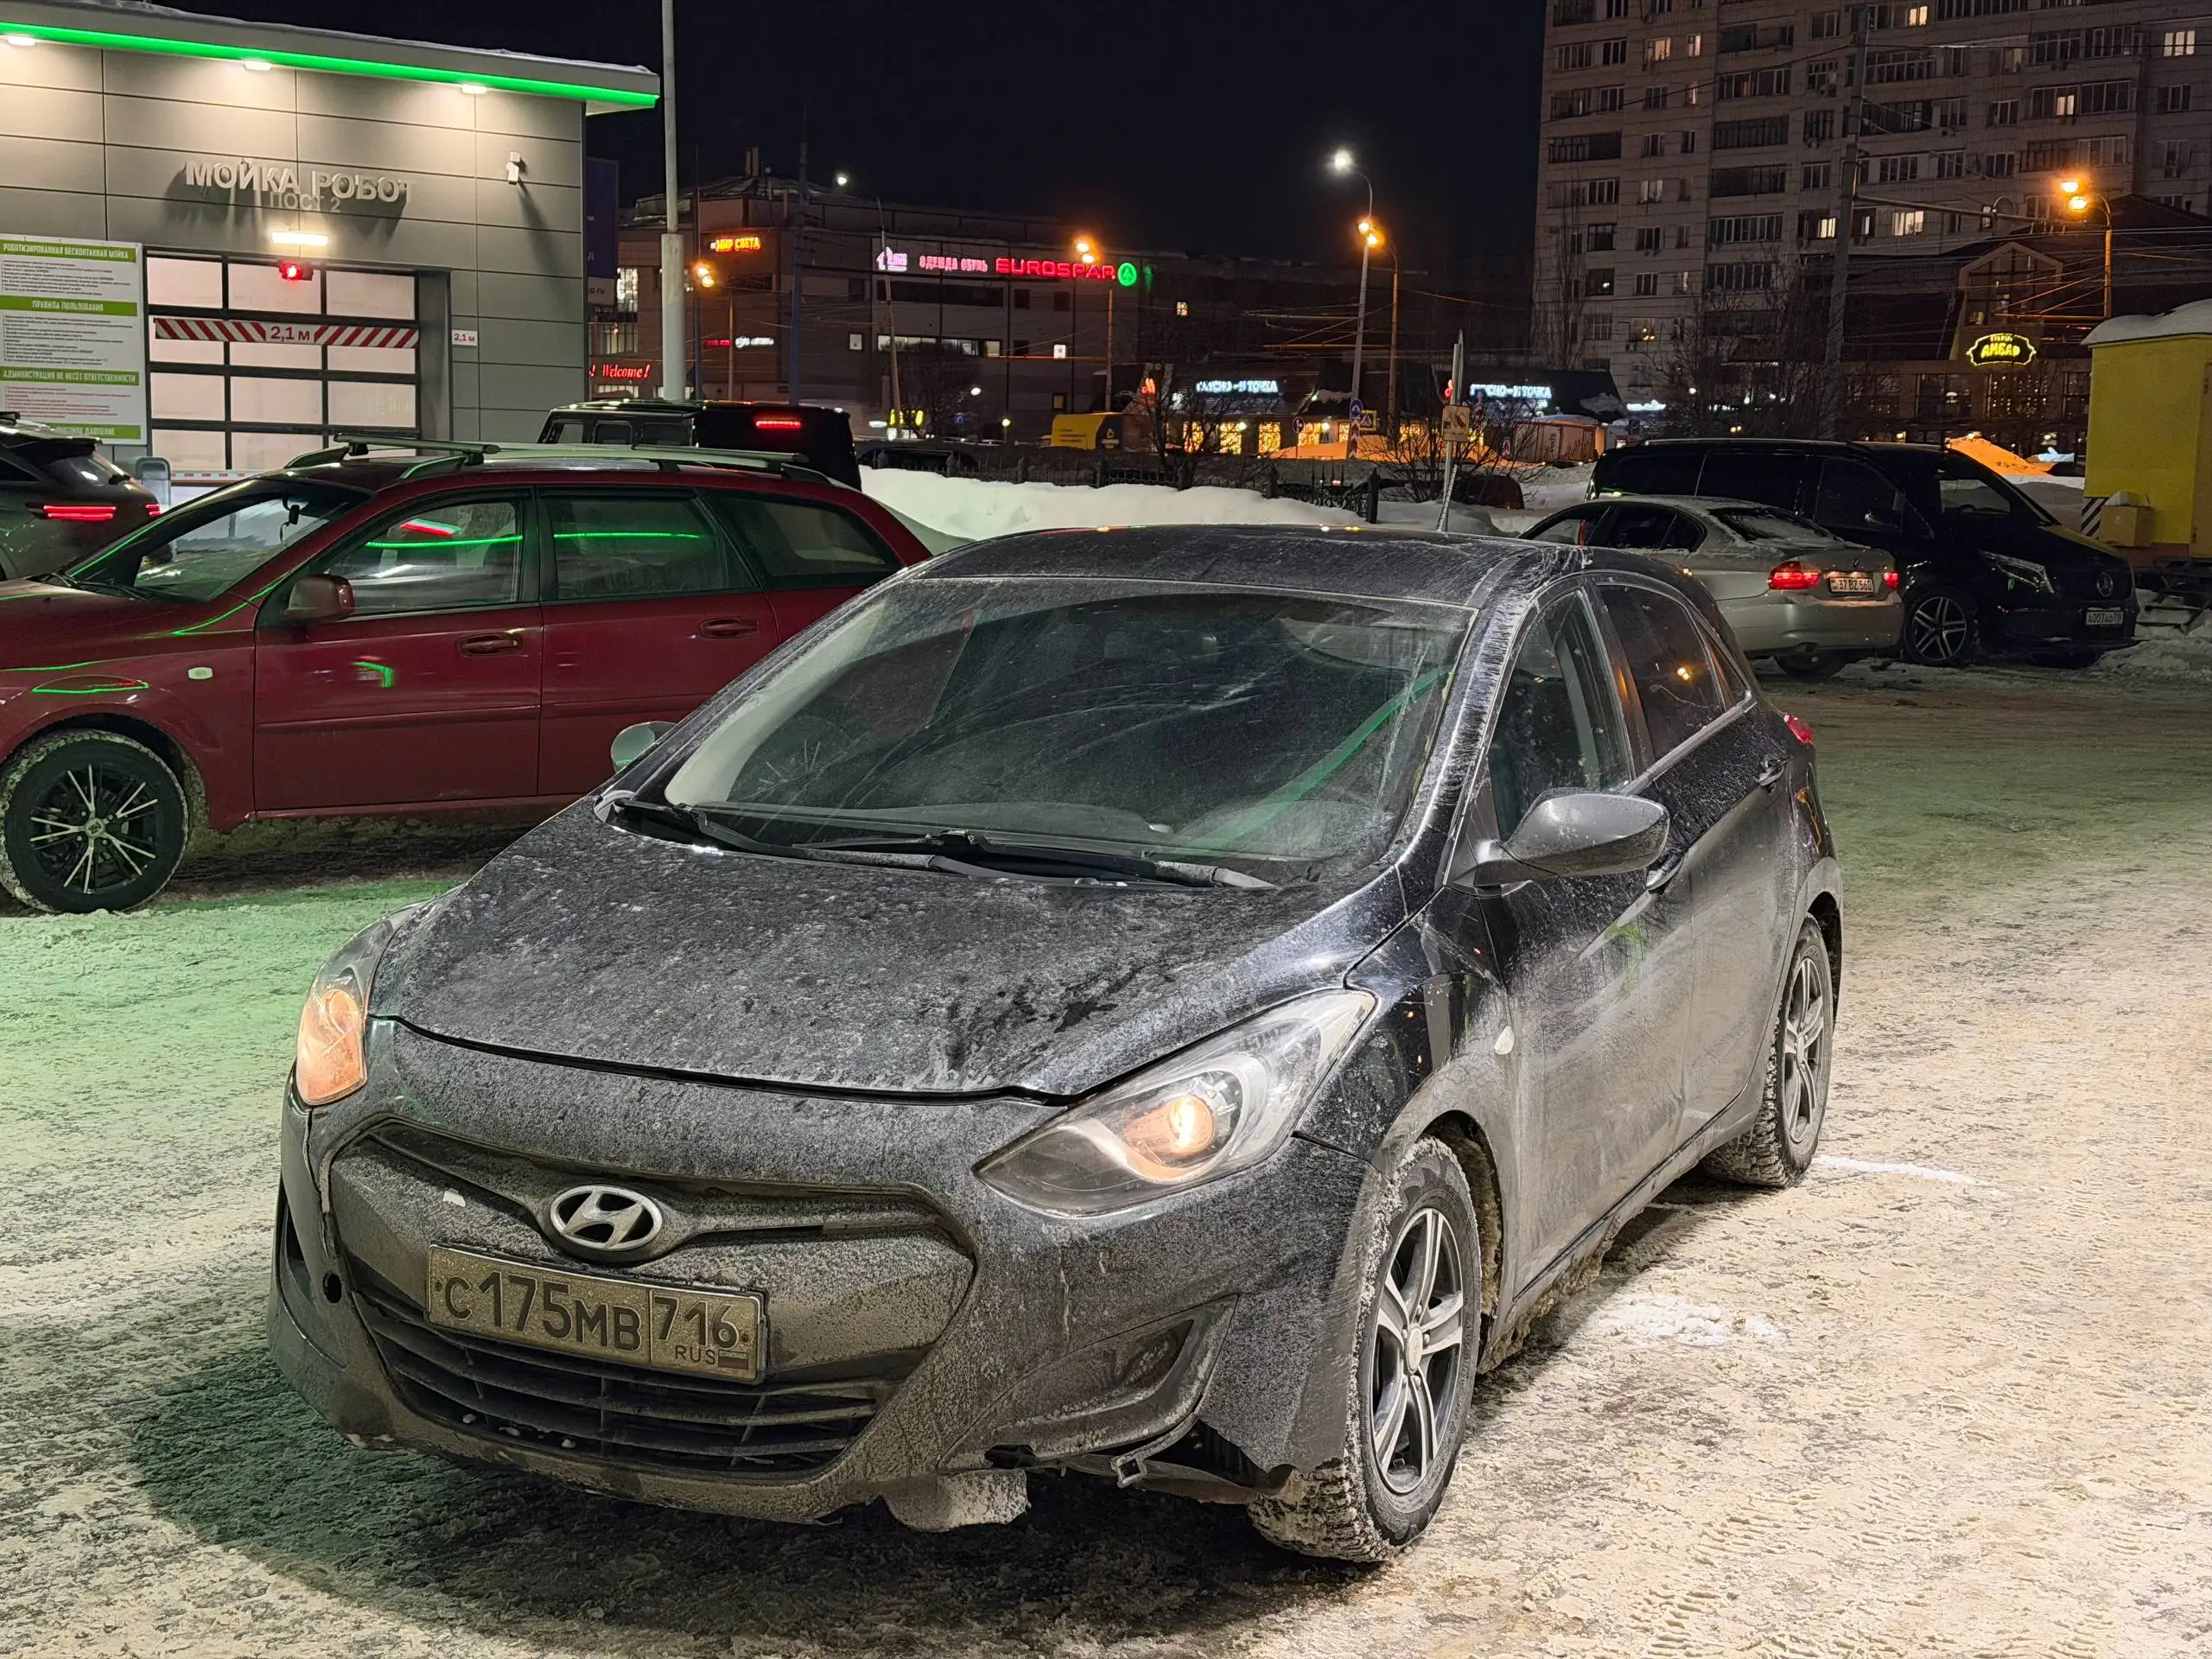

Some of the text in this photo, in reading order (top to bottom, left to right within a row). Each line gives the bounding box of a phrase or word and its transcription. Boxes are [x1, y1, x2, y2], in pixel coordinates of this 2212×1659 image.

[185, 157, 416, 203] МОЙКА РОБОТ
[270, 191, 341, 213] ПОСТ 2
[734, 237, 761, 251] СВЕТА
[109, 248, 129, 259] МОЙКА
[918, 255, 958, 271] ОДЕЖДА
[960, 258, 988, 273] ОБУВЬ
[995, 257, 1116, 281] EUROSPAR
[32, 300, 104, 312] ПРАВИЛА ПОЛЬЗОВАНИЯ
[270, 326, 295, 342] 2,1
[1980, 342, 2021, 359] АМБАР
[3, 370, 55, 379] АДМИНИСТРАЦИЯ
[57, 372, 64, 380] НЕ
[444, 1270, 741, 1353] С175МВ 716
[674, 1345, 717, 1366] RUS
